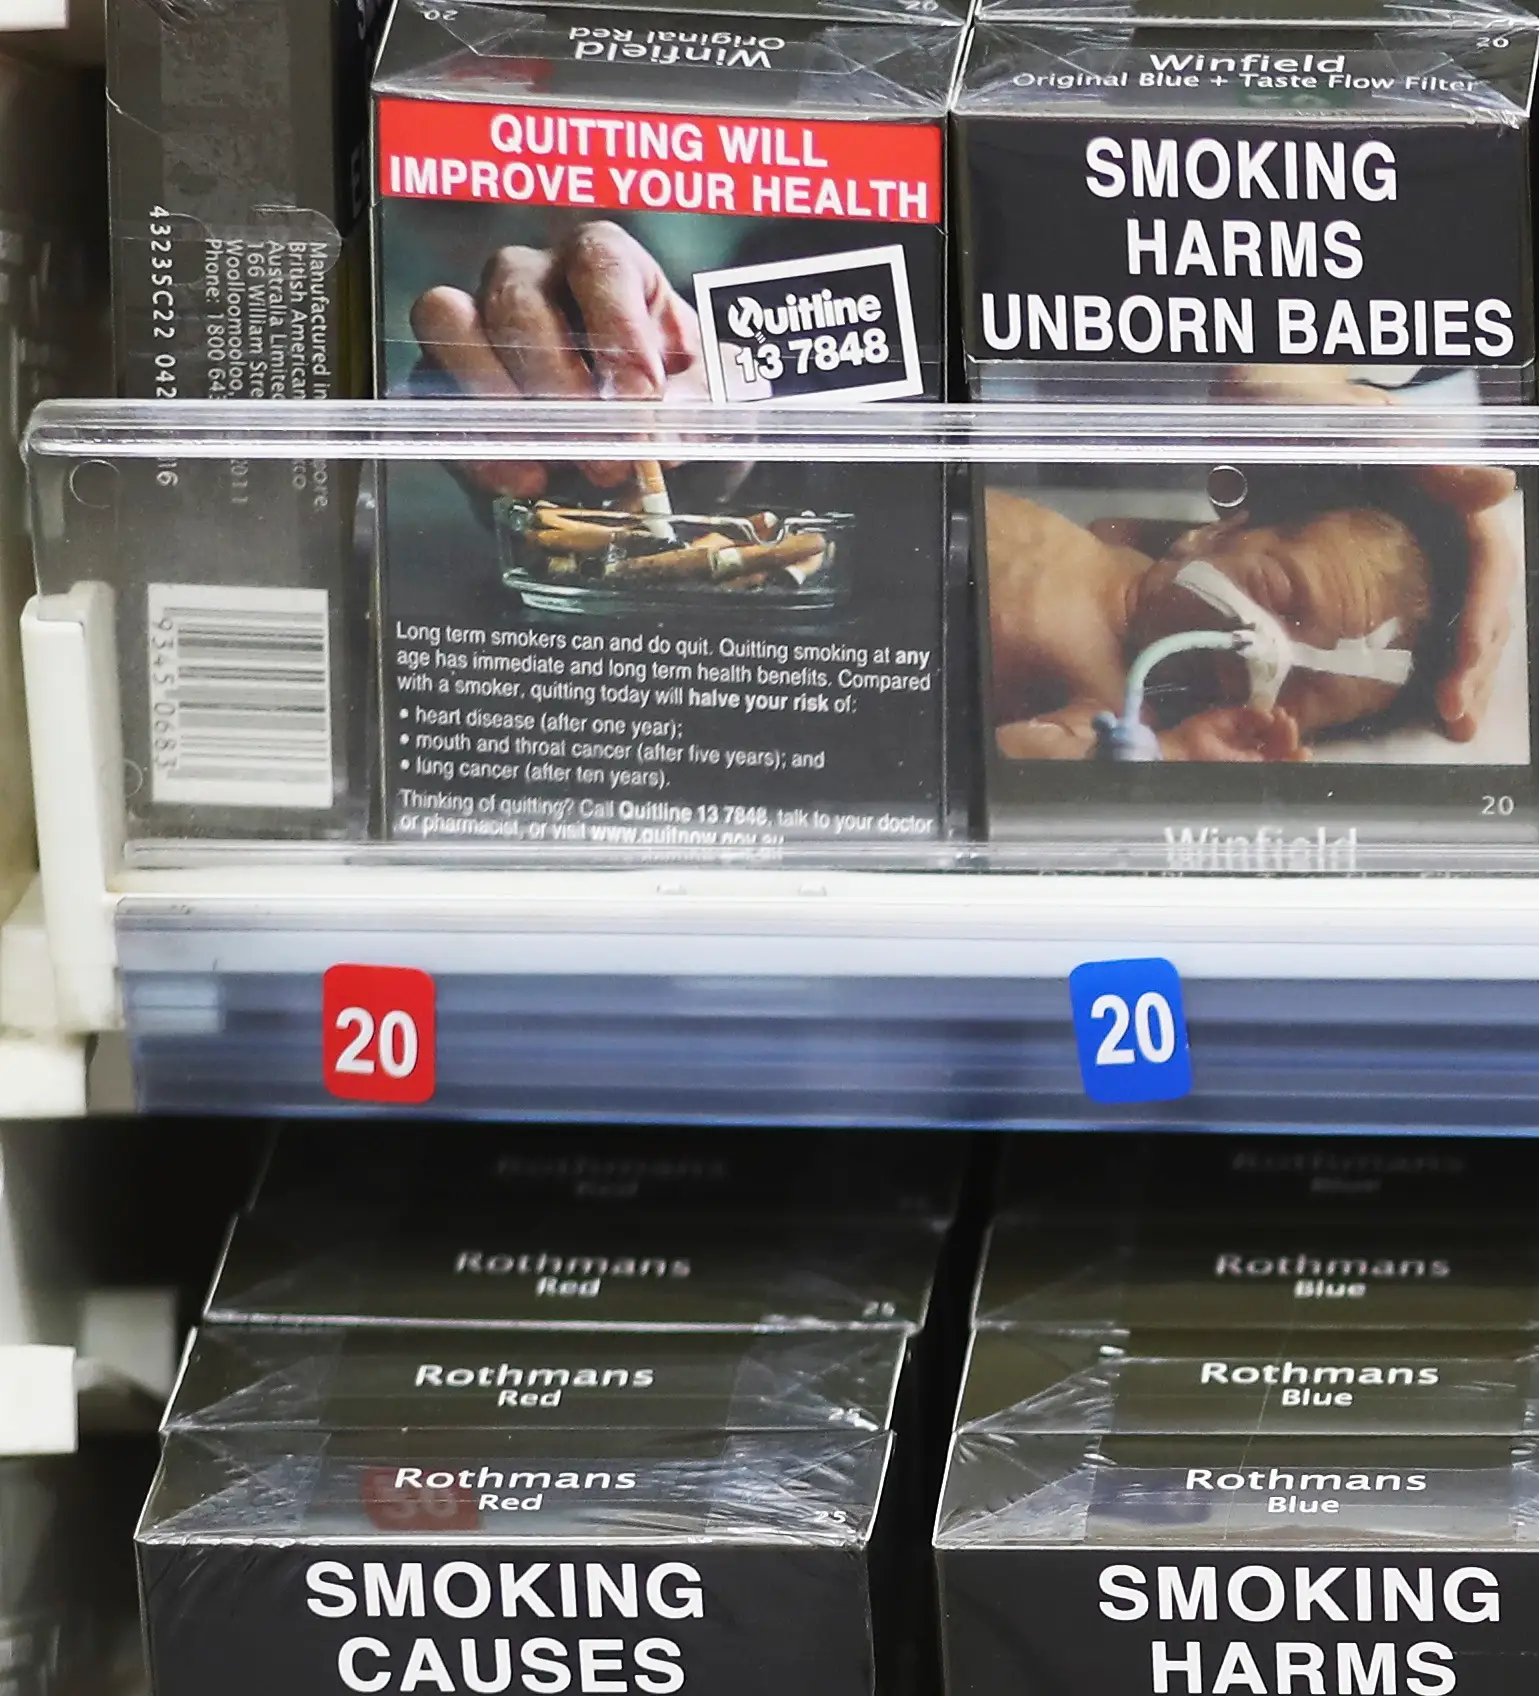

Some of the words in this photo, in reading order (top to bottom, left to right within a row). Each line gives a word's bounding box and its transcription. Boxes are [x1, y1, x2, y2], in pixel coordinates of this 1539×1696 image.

[570, 28, 632, 41] Red
[575, 39, 772, 69] Winfield
[647, 31, 785, 49] Original
[1477, 37, 1508, 47] 20
[1013, 71, 1127, 88] Original
[1140, 72, 1199, 87] Blue
[1239, 74, 1317, 87] Taste
[1329, 74, 1394, 89] Flow
[1406, 74, 1483, 91] Filter
[1150, 54, 1344, 72] Winfield
[491, 114, 702, 161] QUITTING
[719, 126, 827, 167] WILL
[391, 156, 594, 203] IMPROVE
[609, 168, 735, 210] YOUR
[753, 175, 926, 218] HEALTH
[1087, 137, 1396, 201] SMOKING
[204, 239, 223, 303] Phone:
[247, 243, 266, 278] 166
[288, 242, 307, 302] British
[1128, 219, 1363, 278] HARMS
[226, 239, 247, 396] Woolloomooloo,
[247, 284, 267, 354] William
[309, 242, 330, 376] Manufactured
[728, 289, 881, 337] Quitline
[983, 293, 1253, 353] UNBORN
[1279, 299, 1513, 356] BABIES
[735, 343, 783, 382] 13
[788, 327, 889, 373] 7848
[397, 622, 440, 646] Long
[446, 628, 485, 645] term
[491, 630, 567, 648] smokers
[572, 636, 604, 650] can
[610, 635, 643, 652] and
[648, 637, 671, 653] do
[676, 638, 714, 659] quit.
[719, 639, 788, 662] Quitting
[794, 642, 868, 665] smoking
[873, 647, 891, 663] at
[896, 650, 930, 669] any
[416, 706, 461, 727] heart
[466, 707, 535, 729] disease
[541, 711, 587, 734] (after
[592, 719, 626, 734] one
[416, 759, 454, 780] lung
[459, 762, 518, 780] cancer
[525, 764, 571, 783] (after
[577, 767, 605, 783] ten
[336, 1001, 417, 1077] 20
[1091, 992, 1174, 1064] 20
[416, 1364, 653, 1386] Rothmans
[498, 1390, 561, 1406] Red
[395, 1467, 635, 1488] Rothmans
[479, 1494, 542, 1510] Red
[815, 1510, 847, 1524] 25
[306, 1561, 703, 1618] SMOKING
[338, 1637, 684, 1693] CAUSES
